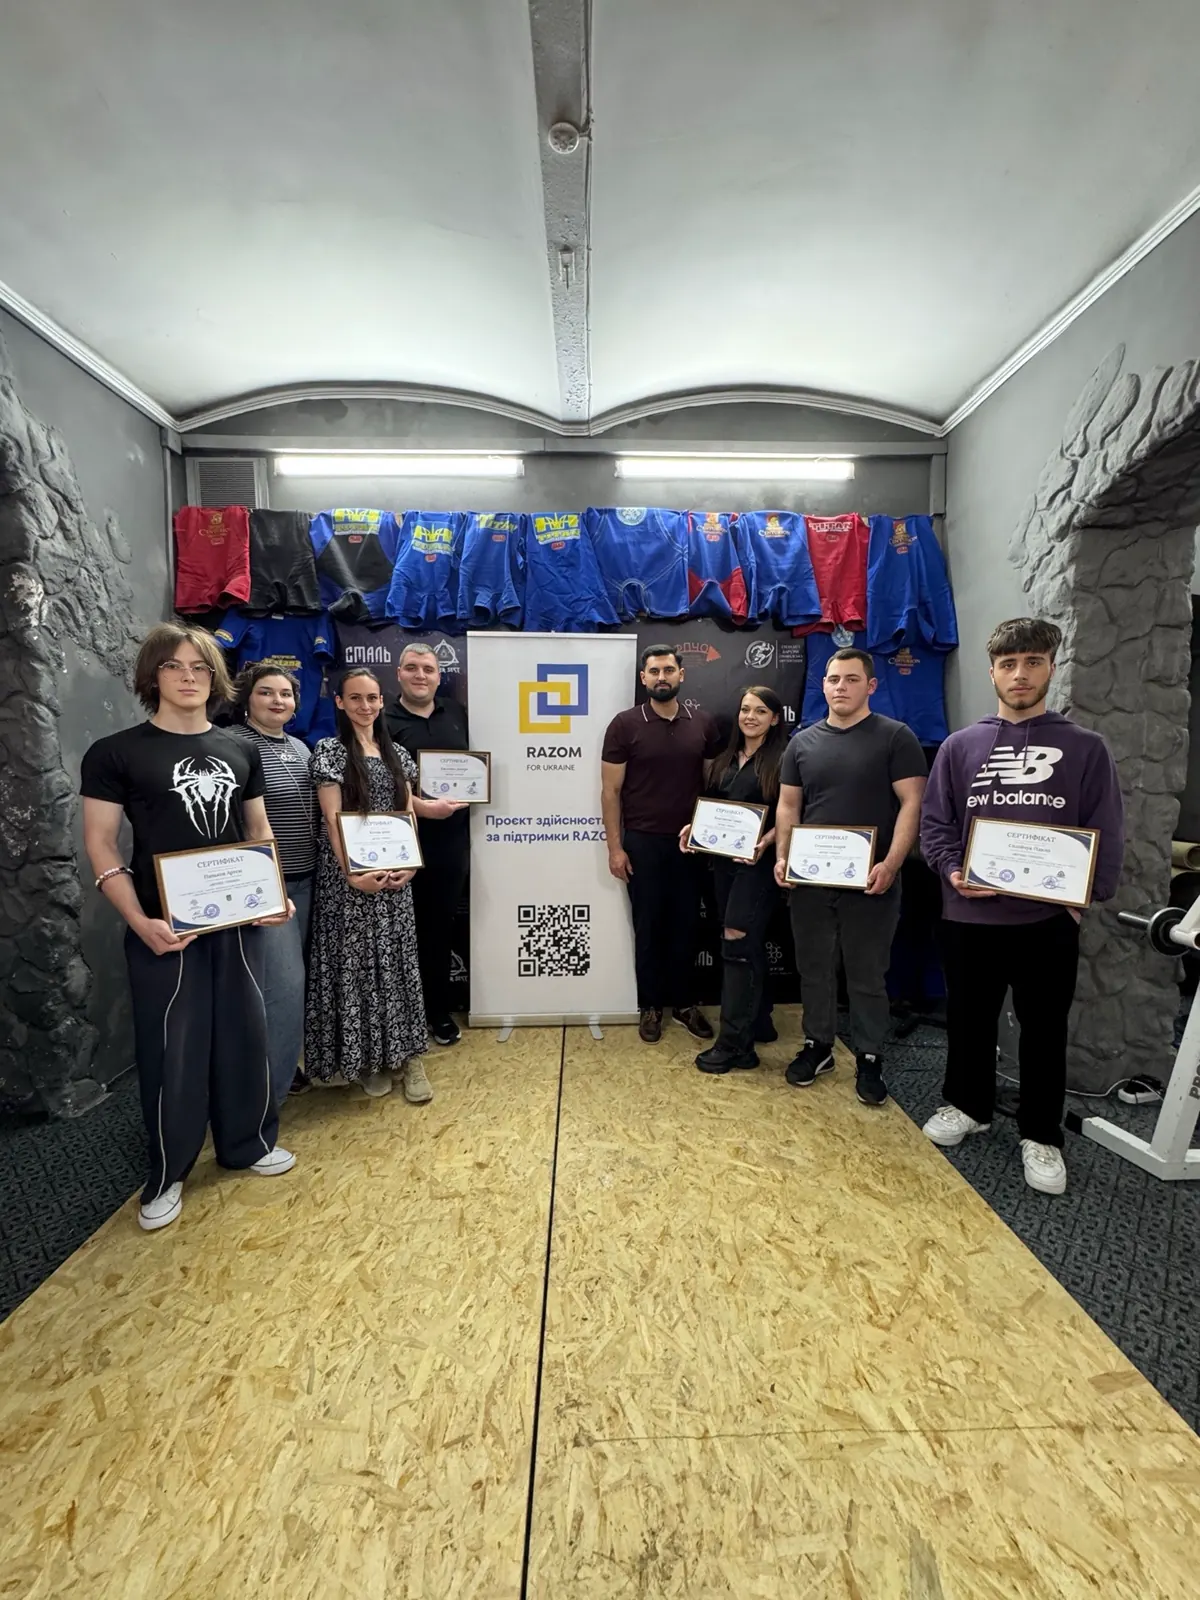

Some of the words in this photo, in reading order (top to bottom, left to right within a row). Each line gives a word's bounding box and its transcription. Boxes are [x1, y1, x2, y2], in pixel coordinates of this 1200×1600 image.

[526, 746, 583, 758] RAZOM
[966, 794, 989, 808] ew
[993, 789, 1066, 809] balance
[485, 815, 533, 828] Проєкт
[536, 814, 604, 827] здійснюєт
[486, 833, 500, 842] за
[503, 831, 569, 844] підтримки
[572, 830, 607, 842] RAZO
[1006, 831, 1057, 843] СЕРТИФІКАТ
[196, 855, 245, 869] СЕРТИФІКАТ
